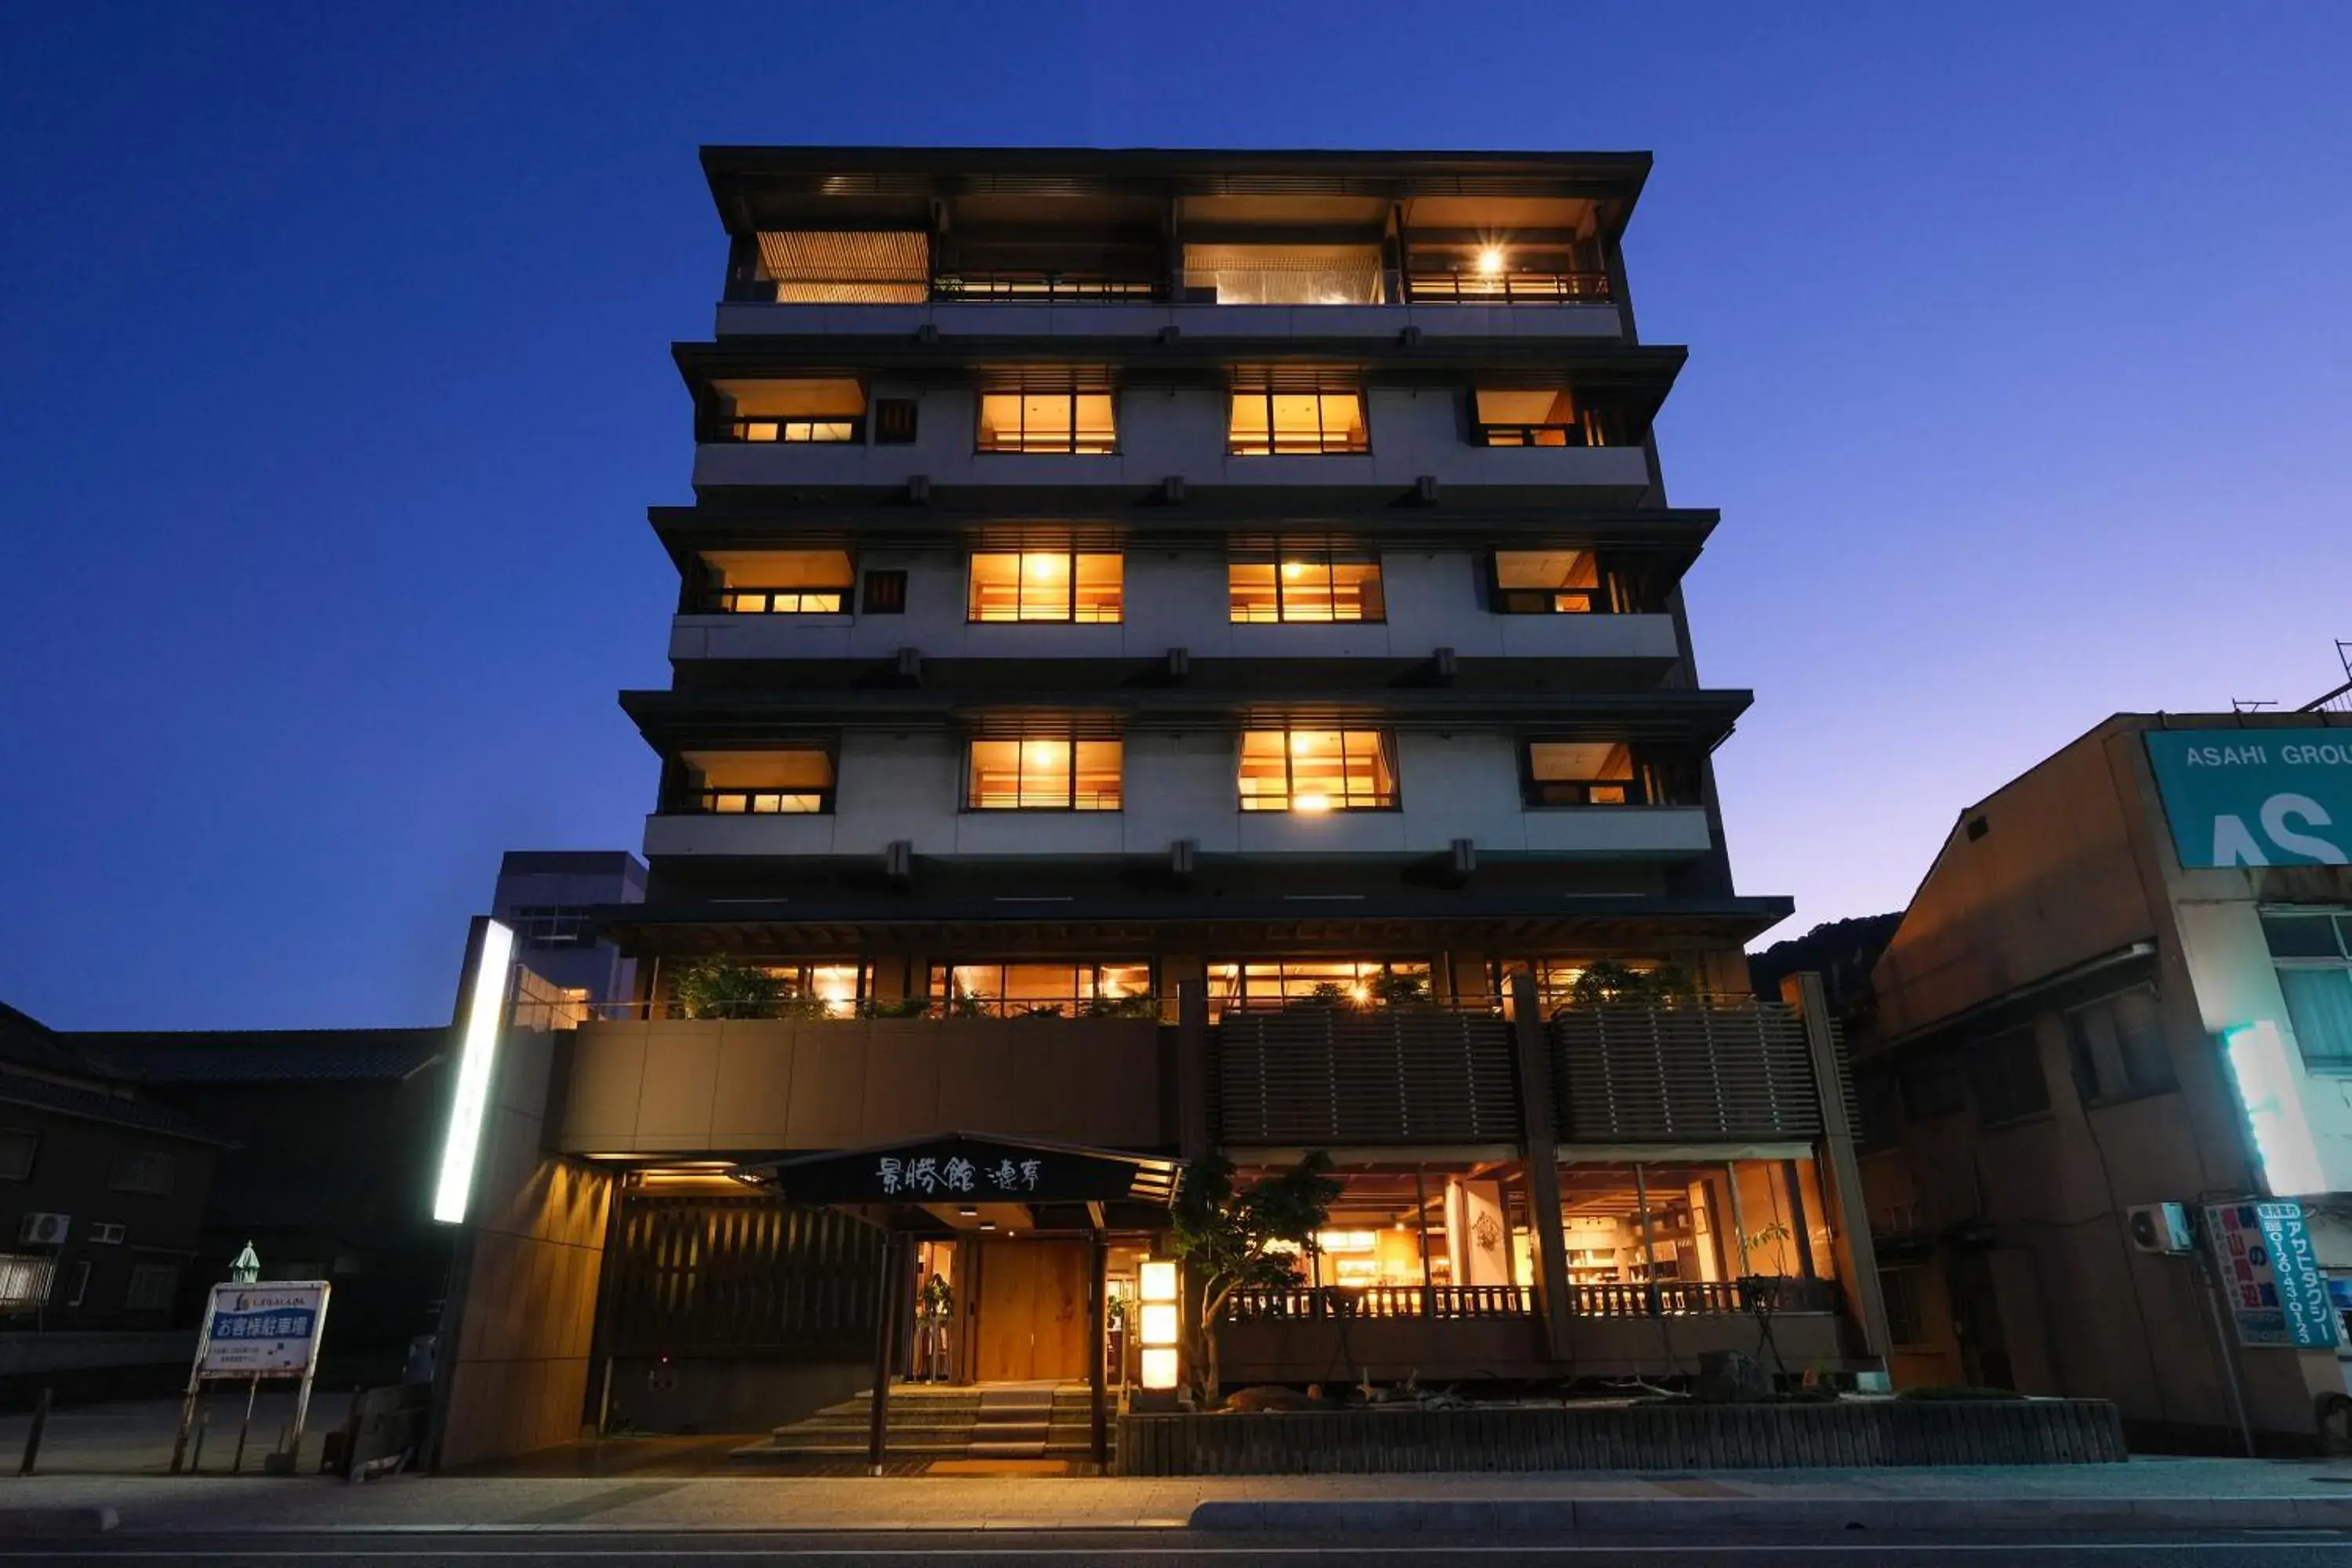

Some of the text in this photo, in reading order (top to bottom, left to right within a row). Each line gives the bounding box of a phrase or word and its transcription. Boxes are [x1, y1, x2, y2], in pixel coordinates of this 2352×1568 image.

[2187, 745, 2268, 766] ASAHI
[875, 1156, 977, 1195] 景勝館
[217, 1315, 308, 1337] お客様駐車場
